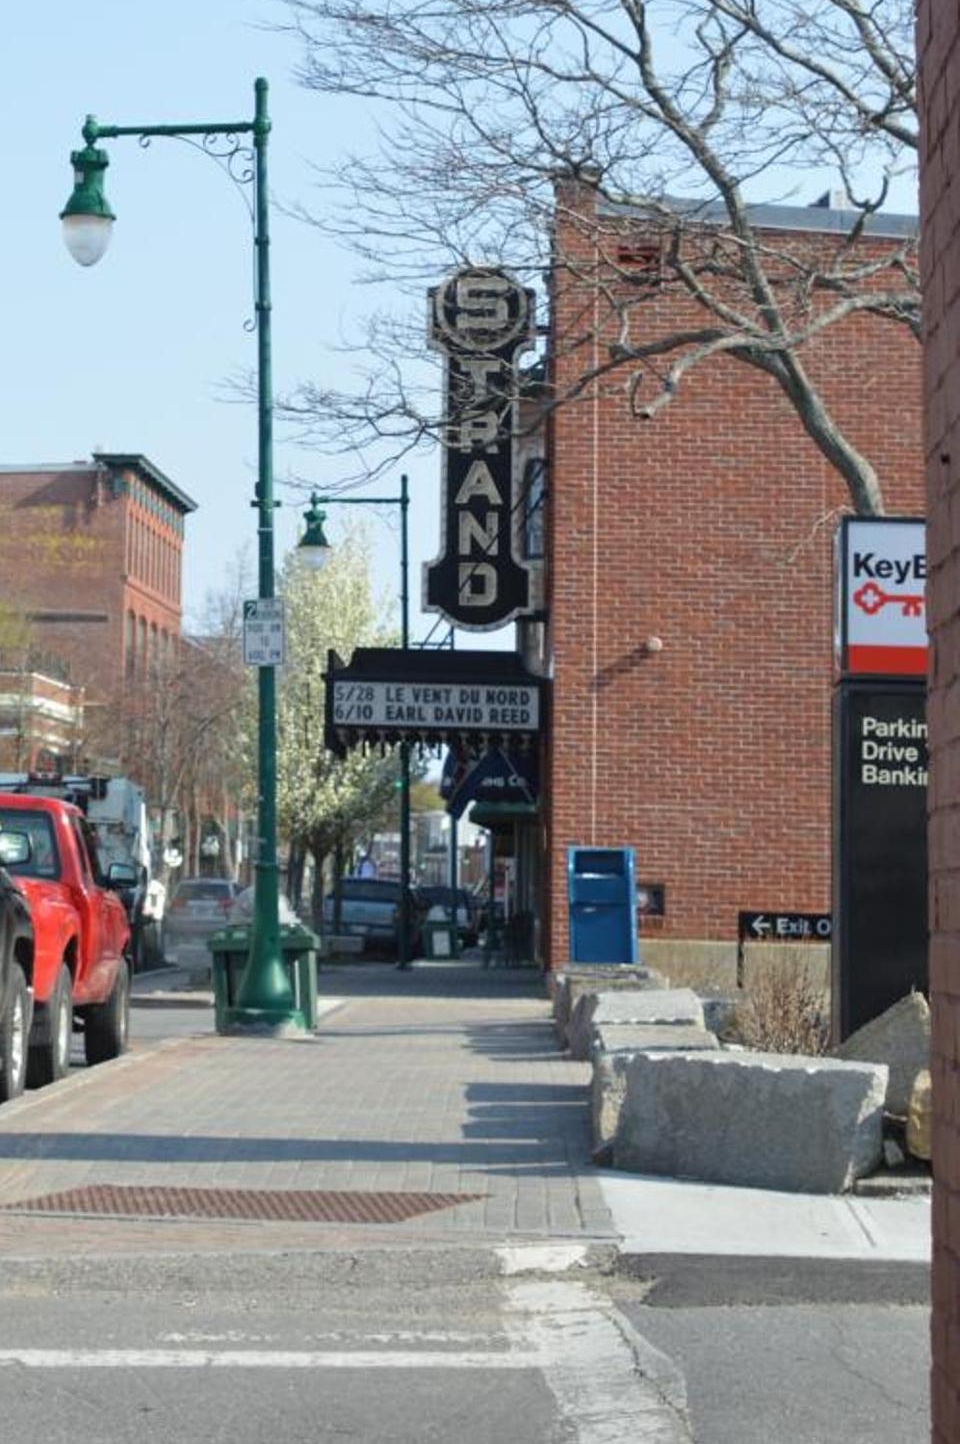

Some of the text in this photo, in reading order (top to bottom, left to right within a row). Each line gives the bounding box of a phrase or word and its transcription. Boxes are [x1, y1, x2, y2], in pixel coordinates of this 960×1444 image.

[453, 275, 510, 607] STRAND
[385, 687, 405, 703] LE
[412, 687, 452, 704] VENT
[459, 688, 480, 705] DU
[485, 689, 531, 706] NORD
[335, 705, 531, 725] 6/10 EARL DAVID REED
[862, 740, 919, 763] Drive
[776, 917, 811, 935] Exit
